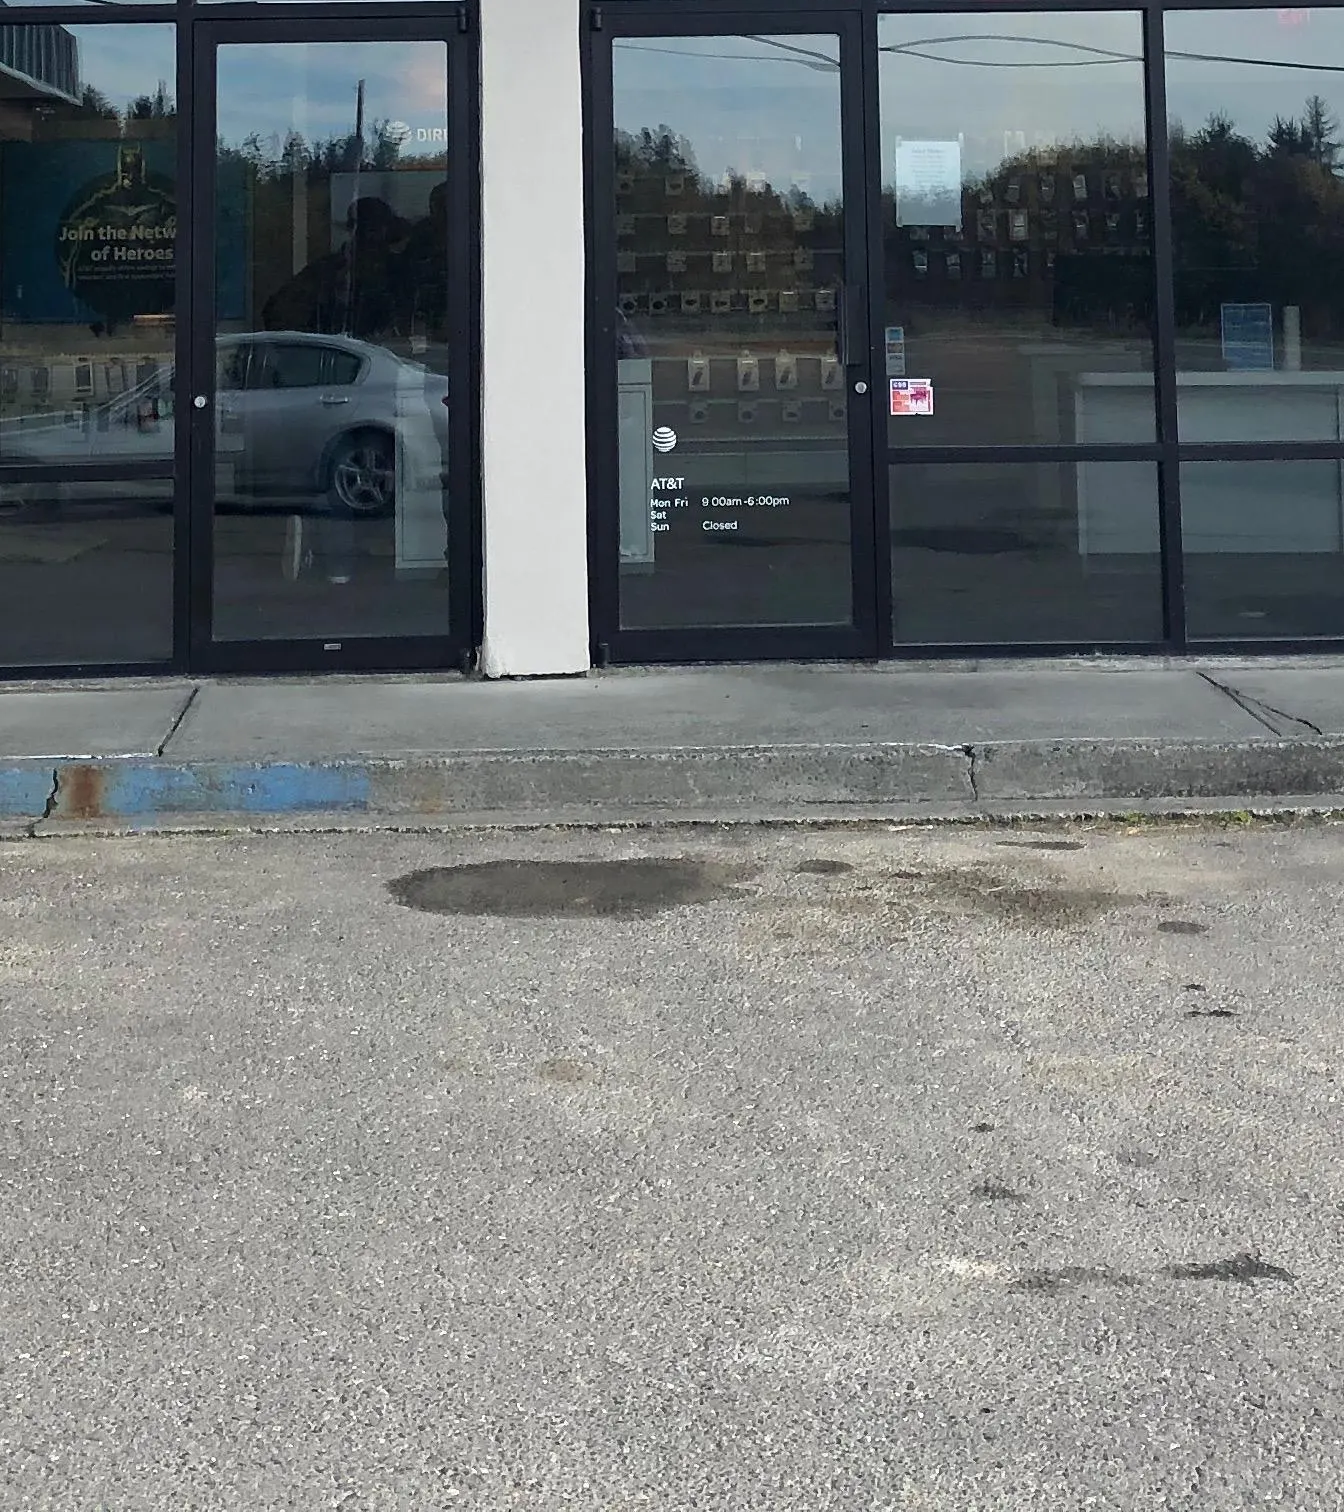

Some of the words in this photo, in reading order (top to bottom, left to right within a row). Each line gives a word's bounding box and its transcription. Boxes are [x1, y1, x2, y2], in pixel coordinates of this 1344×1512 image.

[59, 226, 94, 241] Join
[96, 225, 128, 240] the
[129, 225, 176, 240] Netw
[91, 246, 111, 261] of
[113, 246, 174, 261] Heroes
[650, 478, 684, 490] AT&T
[650, 498, 670, 508] Mon
[674, 497, 689, 507] Fri
[650, 510, 667, 520] Sat
[650, 522, 669, 531] Sun
[702, 520, 738, 530] Closed
